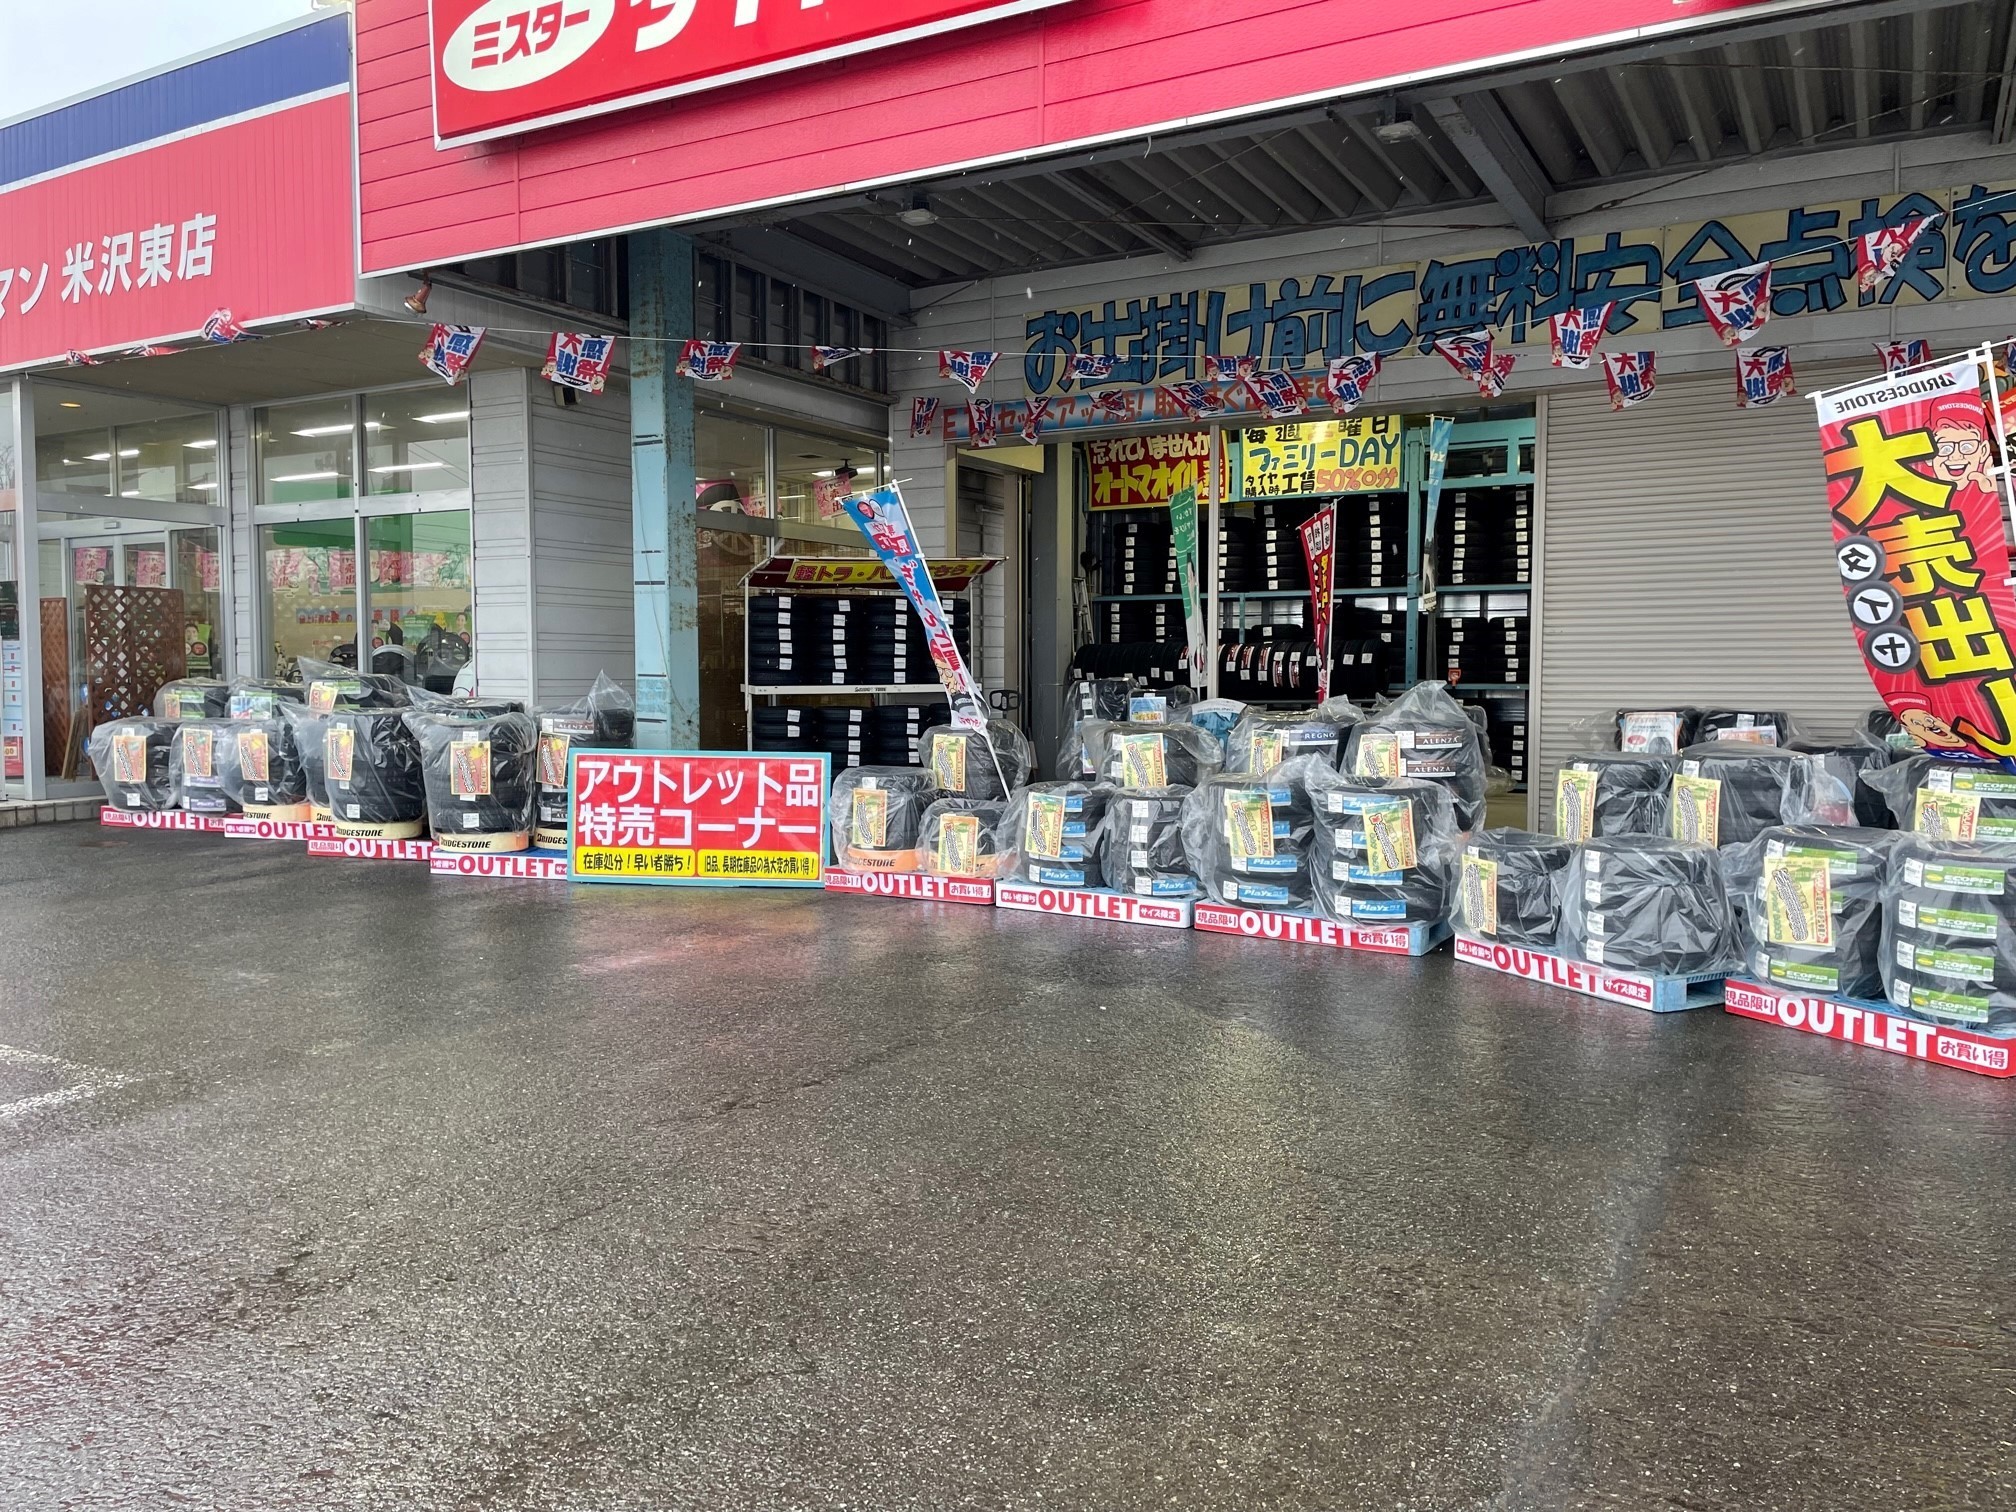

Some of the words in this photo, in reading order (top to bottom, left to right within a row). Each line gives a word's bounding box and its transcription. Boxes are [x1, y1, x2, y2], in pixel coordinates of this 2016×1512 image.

[470, 8, 590, 70] ミスター
[61, 212, 217, 304] 米沢東店
[1245, 472, 1278, 486] タイヤ
[1304, 732, 1335, 740] REGNO
[1422, 736, 1459, 745] ALENZA
[1414, 765, 1450, 773] ALENZA
[578, 759, 819, 808] アウトレット品
[132, 812, 205, 830] OUTLET
[257, 821, 336, 839] OUTLET
[578, 802, 817, 849] 特売コーナー
[343, 839, 432, 860] OUTLET
[537, 832, 568, 845] BRIDGES
[458, 855, 553, 877] OUTLET
[861, 873, 949, 898] OUTLET
[1038, 889, 1138, 921] OUTLET
[1197, 911, 1238, 928] 現品限り
[1239, 911, 1352, 947] OUTLET
[1360, 932, 1407, 948] お買い得
[1493, 945, 1602, 994] OUTLET
[1725, 990, 1775, 1013] 現品限り
[1777, 998, 1937, 1058] OUTLET
[1940, 1040, 2006, 1068] お買い得
